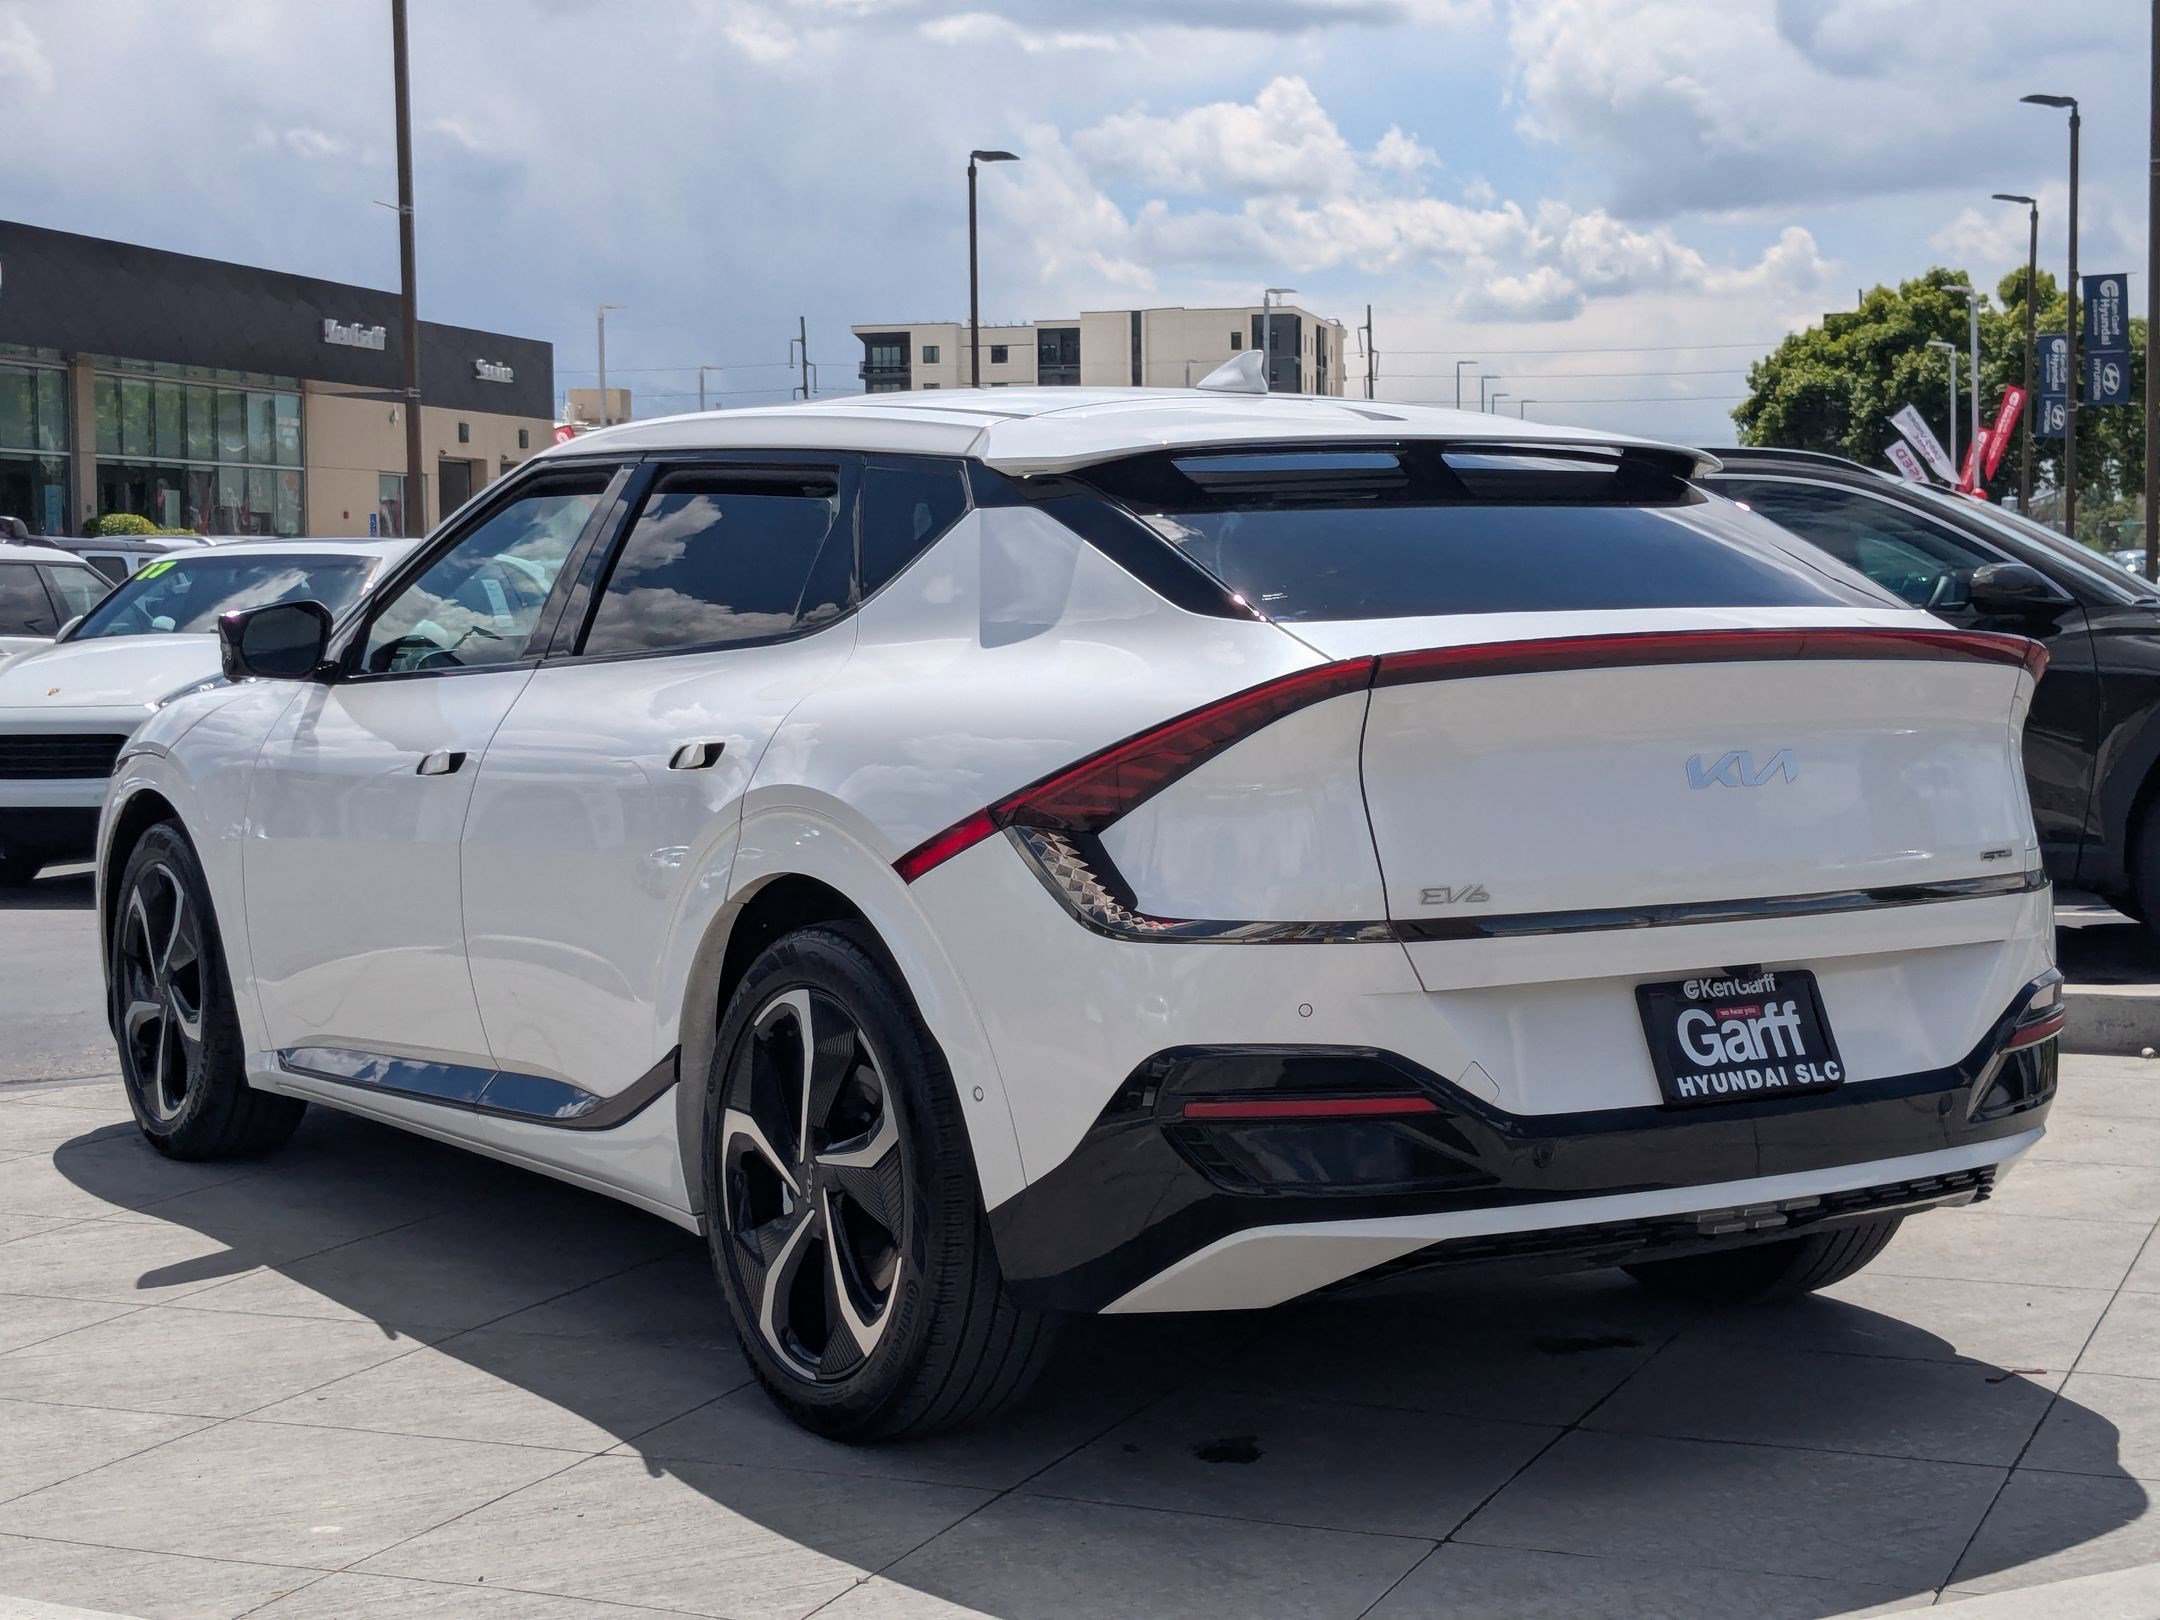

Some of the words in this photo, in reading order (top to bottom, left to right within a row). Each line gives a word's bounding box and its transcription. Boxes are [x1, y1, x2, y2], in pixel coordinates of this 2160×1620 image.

[2099, 298, 2111, 345] Hyundai
[1685, 748, 1798, 790] KIA
[1419, 884, 1490, 905] EV6
[1676, 1000, 1806, 1067] Garff
[1676, 1066, 1789, 1098] HYUNDAI
[1794, 1060, 1841, 1084] SLC
